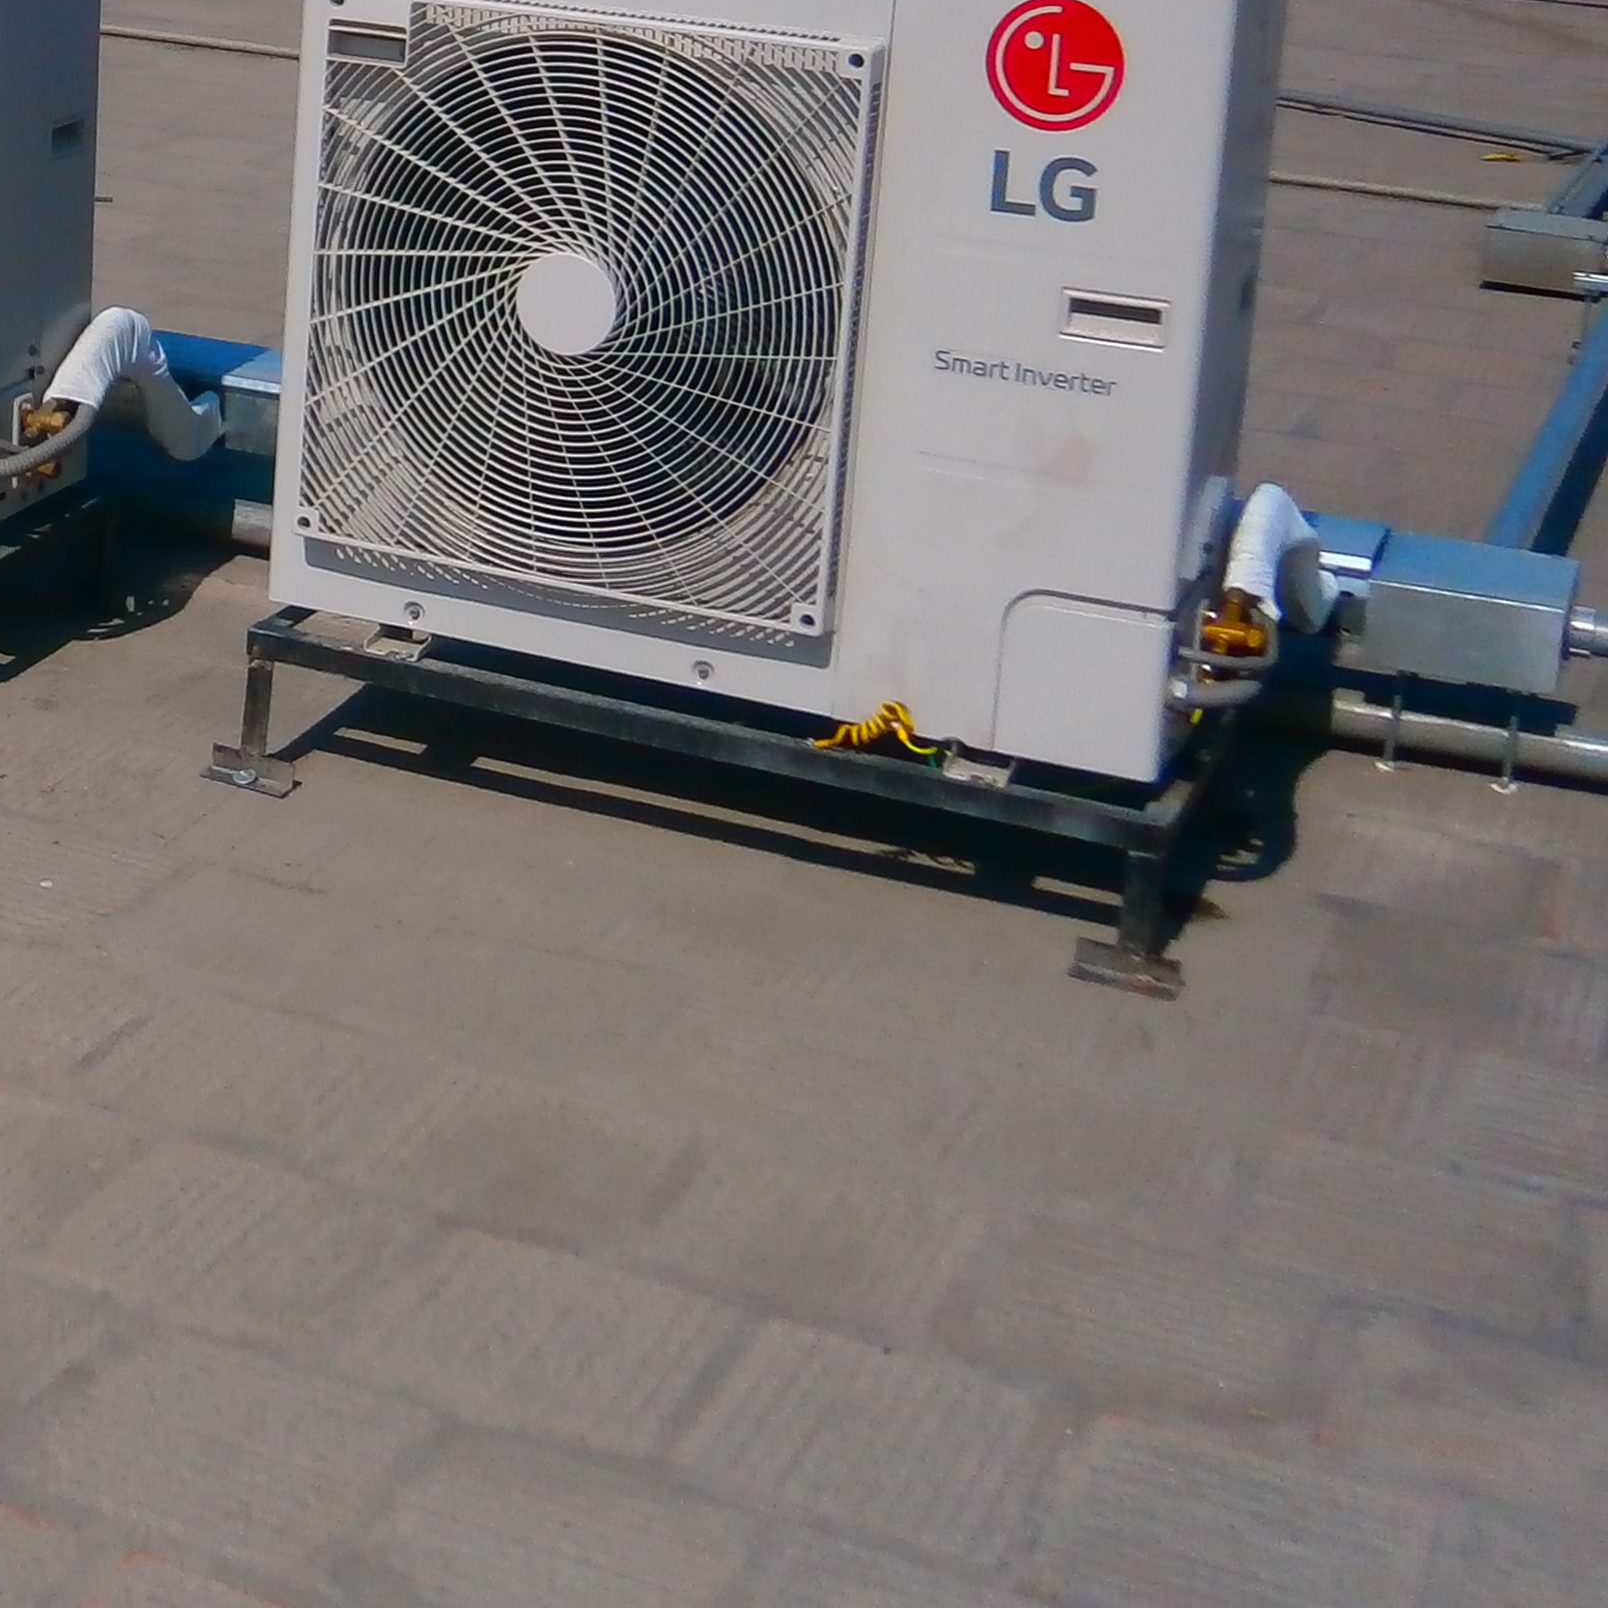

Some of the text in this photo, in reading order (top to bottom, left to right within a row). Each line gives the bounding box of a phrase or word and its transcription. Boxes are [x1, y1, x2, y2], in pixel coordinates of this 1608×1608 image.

[990, 150, 1098, 223] LG
[934, 349, 1118, 397] Smart Inverter
